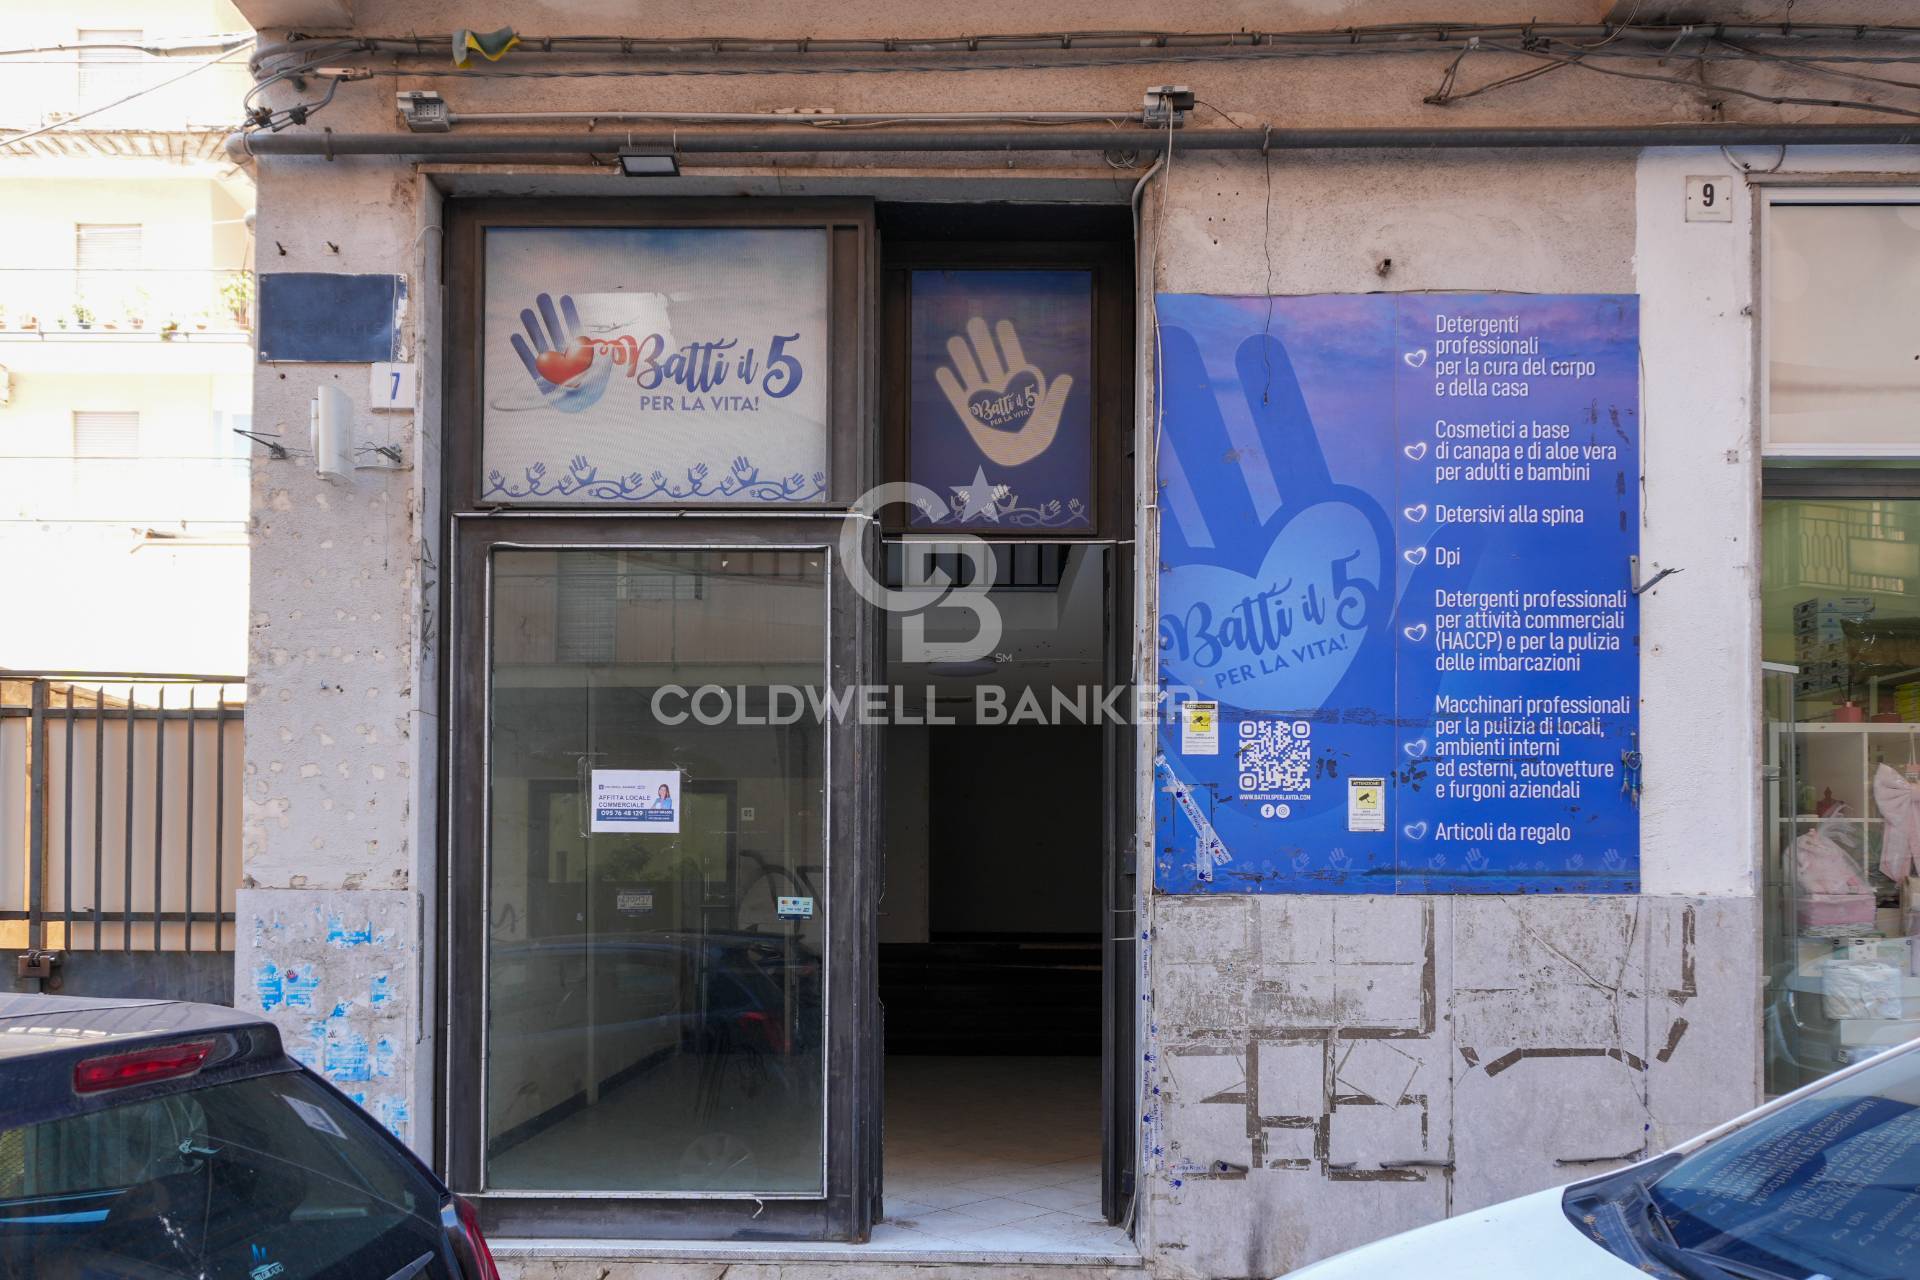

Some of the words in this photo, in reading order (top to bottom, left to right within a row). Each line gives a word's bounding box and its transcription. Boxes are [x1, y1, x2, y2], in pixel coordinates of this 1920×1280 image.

[1703, 183, 1714, 207] 9
[1436, 315, 1519, 337] Detergenti
[1436, 337, 1539, 357] professionali
[628, 332, 737, 393] Batti
[737, 348, 758, 386] il
[762, 332, 803, 399] 5
[1436, 361, 1461, 378] per
[1466, 358, 1480, 375] la
[1484, 361, 1519, 376] cura
[1523, 358, 1547, 376] del
[1551, 361, 1596, 379] corpo
[390, 372, 401, 400] 7
[1435, 382, 1445, 396] e
[1449, 378, 1488, 396] della
[1492, 382, 1529, 396] casa
[640, 395, 674, 411] PER
[681, 395, 705, 411] LA
[711, 395, 760, 412] VITA!
[968, 392, 1015, 420] Batti
[1024, 383, 1039, 409] 5
[990, 417, 1003, 426] PER
[1004, 415, 1013, 423] LA
[1435, 420, 1515, 438] Cosmetici
[1519, 423, 1529, 438] a
[1532, 421, 1570, 438] base
[1435, 442, 1449, 459] di
[1453, 445, 1510, 463] canapa
[1514, 445, 1524, 459] e
[1528, 442, 1541, 459] di
[1545, 442, 1579, 459] aloe
[1583, 445, 1617, 460] vera
[1436, 466, 1461, 484] per
[1466, 463, 1510, 480] adulti
[1514, 466, 1524, 480] e
[1528, 463, 1590, 480] bambini
[1435, 505, 1505, 523] Detersivi
[1509, 505, 1538, 523] alla
[1542, 505, 1584, 527] spina
[1435, 547, 1460, 568] Dpi
[1160, 577, 1293, 668] Batti
[1302, 583, 1325, 626] il
[1331, 549, 1379, 631] 5
[1435, 590, 1519, 611] Detergenti
[1524, 590, 1627, 610] professionali
[1436, 614, 1461, 631] per
[1465, 610, 1520, 629] attività
[1525, 612, 1624, 629] commerciali
[1435, 631, 1503, 651] (HACCP)
[1507, 636, 1516, 650] e
[1520, 636, 1546, 653] per
[1550, 632, 1564, 650] la
[1568, 632, 1620, 653] pulizia
[1214, 664, 1256, 689] PER
[1260, 657, 1290, 676] LA
[1292, 633, 1349, 664] VITA!
[1435, 653, 1475, 671] delle
[1479, 653, 1580, 671] imbarcazioni
[1435, 696, 1522, 714] Macchinari
[1527, 696, 1630, 716] professionali
[1436, 720, 1461, 737] per
[1466, 717, 1480, 735] la
[1484, 717, 1535, 737] pulizia
[1539, 717, 1553, 735] di
[1558, 717, 1605, 738] locali,
[1435, 738, 1505, 756] ambienti
[1509, 738, 1560, 756] interni
[1435, 759, 1455, 777] ed
[1459, 759, 1518, 779] esterni,
[1521, 762, 1614, 777] autovetture
[1435, 783, 1445, 798] e
[1449, 781, 1505, 801] furgoni
[1509, 781, 1580, 798] aziendali
[1435, 823, 1493, 841] Articoli
[1498, 823, 1516, 841] da
[1520, 823, 1571, 844] regalo
